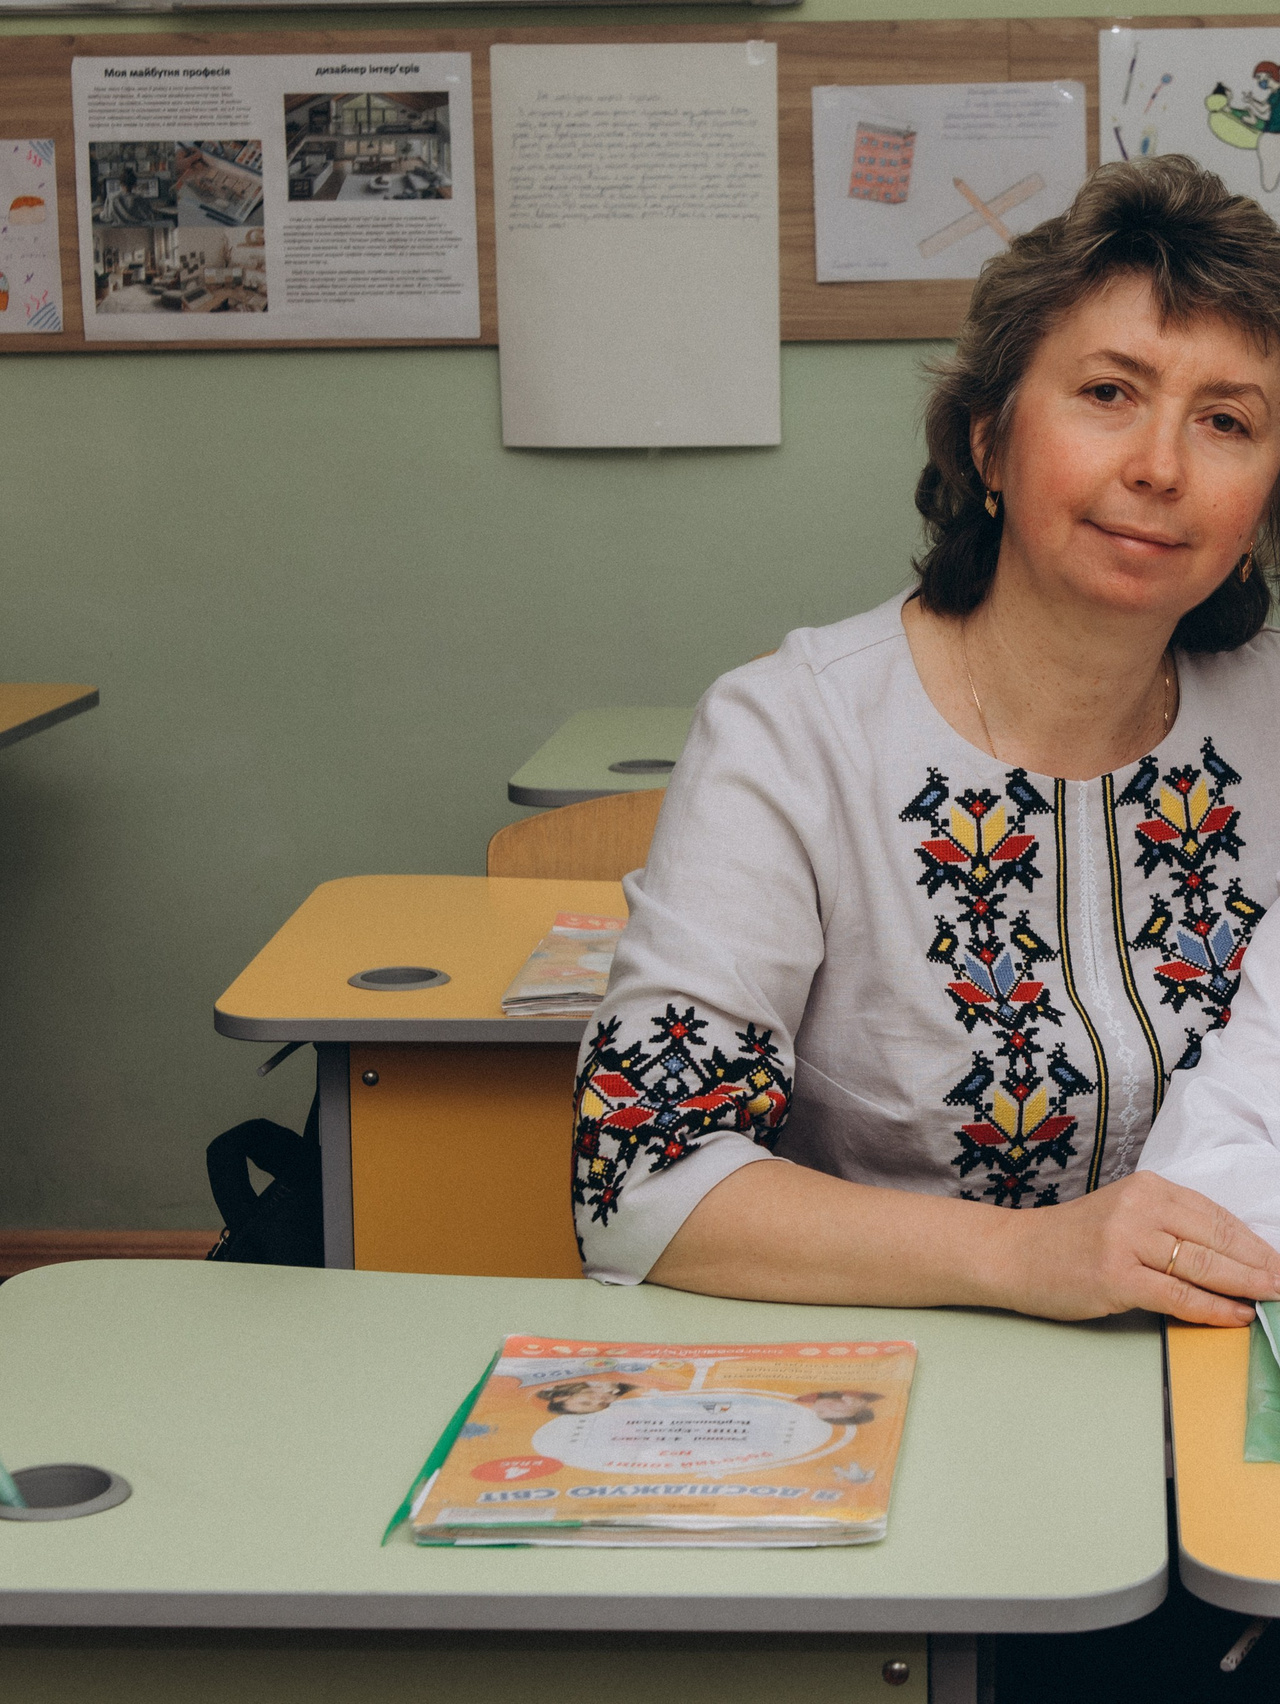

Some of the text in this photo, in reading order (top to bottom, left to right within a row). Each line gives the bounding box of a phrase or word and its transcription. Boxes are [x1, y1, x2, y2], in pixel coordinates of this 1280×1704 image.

[104, 65, 231, 79] Моя майбутня професія
[315, 64, 367, 76] дизайнер
[504, 1467, 531, 1480] 4
[479, 1486, 559, 1503] СВІТ
[567, 1483, 808, 1498] ДОСЛІДЖУЮ
